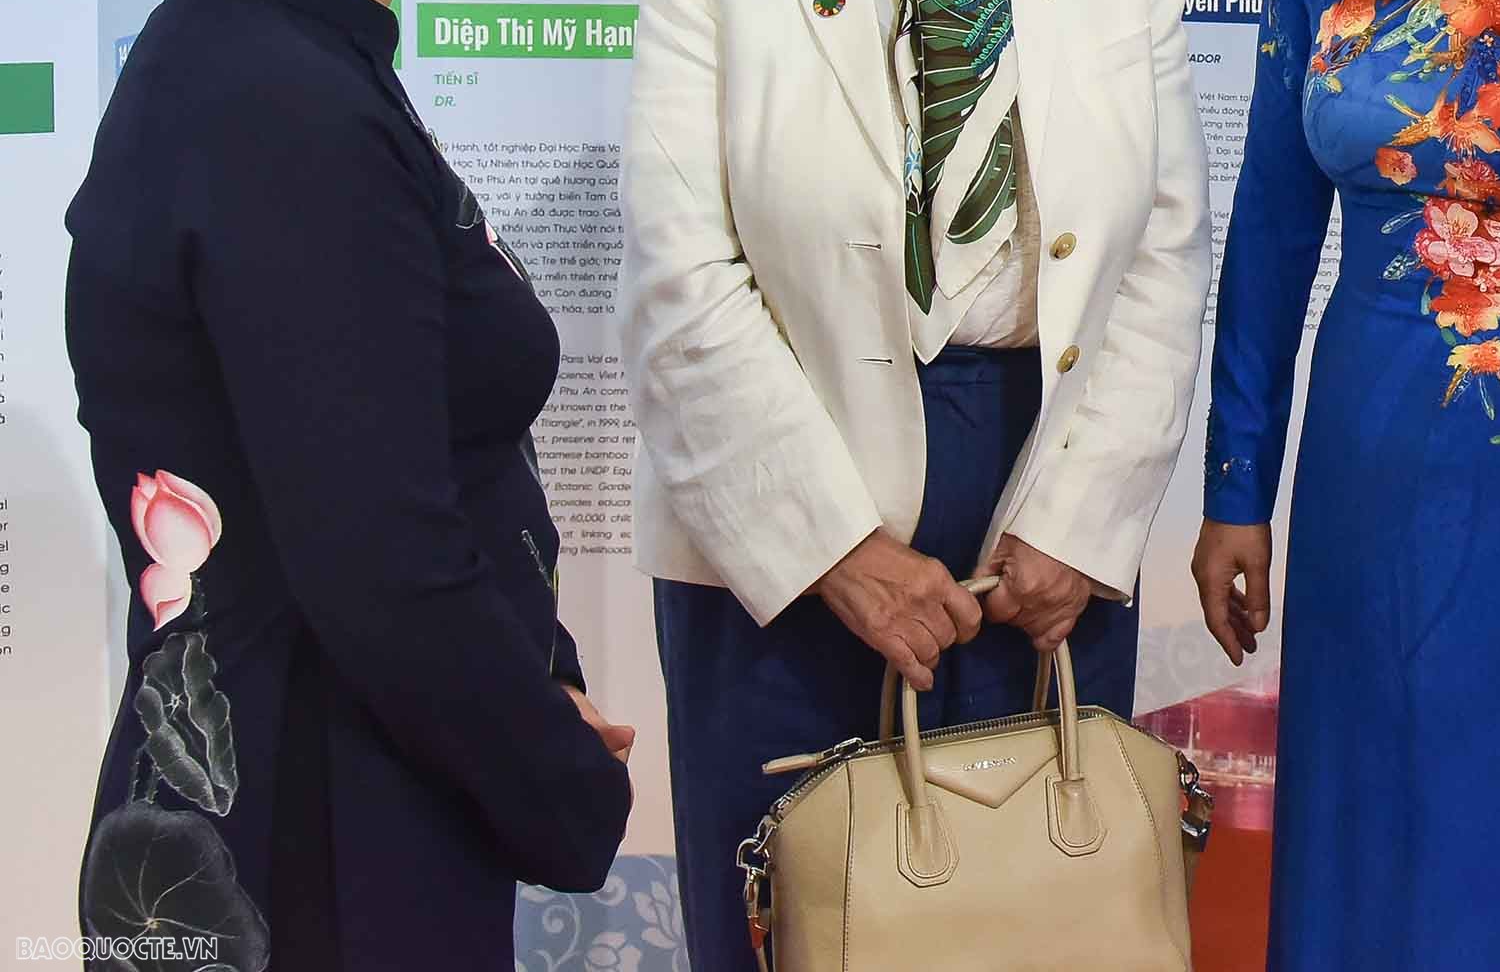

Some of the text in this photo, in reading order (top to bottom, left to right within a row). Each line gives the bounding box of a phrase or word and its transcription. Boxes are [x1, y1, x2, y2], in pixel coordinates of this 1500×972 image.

[434, 16, 490, 52] Diệp
[497, 17, 533, 52] Thị
[543, 18, 578, 51] Mỹ
[1187, 53, 1222, 64] ADOR
[434, 70, 479, 86] TIẾN SĨ
[1218, 93, 1238, 102] Nam
[501, 141, 536, 155] nghiệp
[539, 142, 557, 154] Đại
[559, 143, 579, 155] Học
[582, 143, 606, 153] Paris
[521, 158, 550, 170] thuộc
[573, 159, 593, 171] Học
[469, 175, 483, 185] Tre
[509, 175, 522, 185] An
[540, 174, 561, 188] quê
[584, 191, 607, 202] Tam
[513, 207, 528, 217] An
[578, 208, 599, 218] trao
[541, 257, 557, 266] Tre
[555, 288, 576, 298] Con
[560, 355, 585, 364] Paris
[604, 355, 619, 364] de
[599, 371, 617, 380] Viet
[559, 387, 579, 396] Phu
[582, 387, 597, 395] An
[560, 403, 594, 412] known
[595, 404, 608, 412] as
[610, 403, 627, 412] the
[587, 419, 597, 428] in
[551, 436, 595, 445] preserve
[598, 435, 619, 444] and
[584, 451, 629, 460] bamboo
[560, 467, 577, 476] the
[580, 466, 610, 476] UNDP
[553, 482, 593, 491] Botanic
[550, 498, 593, 509] provides
[568, 513, 607, 524] 60,000
[561, 530, 574, 540] at
[581, 529, 612, 541] linking
[580, 546, 633, 555] livelihoods
